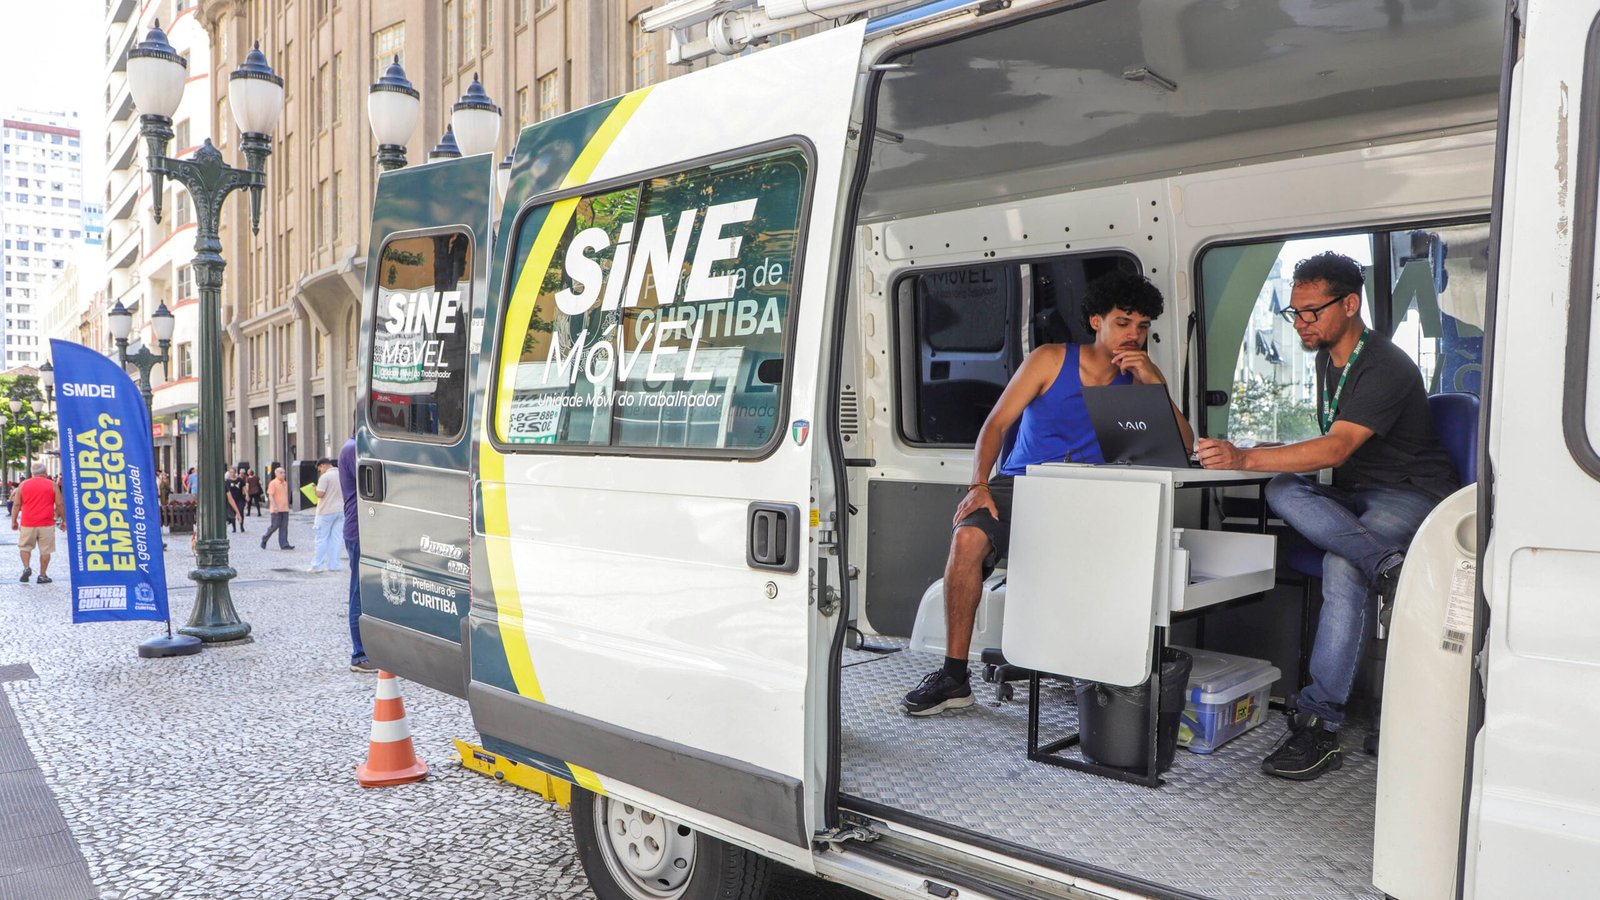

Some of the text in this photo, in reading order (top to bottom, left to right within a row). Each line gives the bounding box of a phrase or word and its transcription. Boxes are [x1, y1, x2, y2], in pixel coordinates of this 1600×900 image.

[752, 257, 783, 286] de
[634, 297, 782, 342] CURITIBA
[62, 383, 116, 399] SMDEI
[538, 393, 583, 407] Unidade
[618, 391, 634, 406] do
[638, 390, 722, 407] Trabalhador
[1117, 421, 1147, 430] VAIO
[76, 428, 111, 572] PROCURA
[98, 413, 137, 572] EMPREGO?
[127, 464, 151, 573] A gente te ajuda!
[78, 587, 127, 599] EMPREGA
[412, 577, 456, 598] Prefeitura de
[78, 598, 127, 609] CURITIBA
[411, 591, 459, 616] CURITIBA
